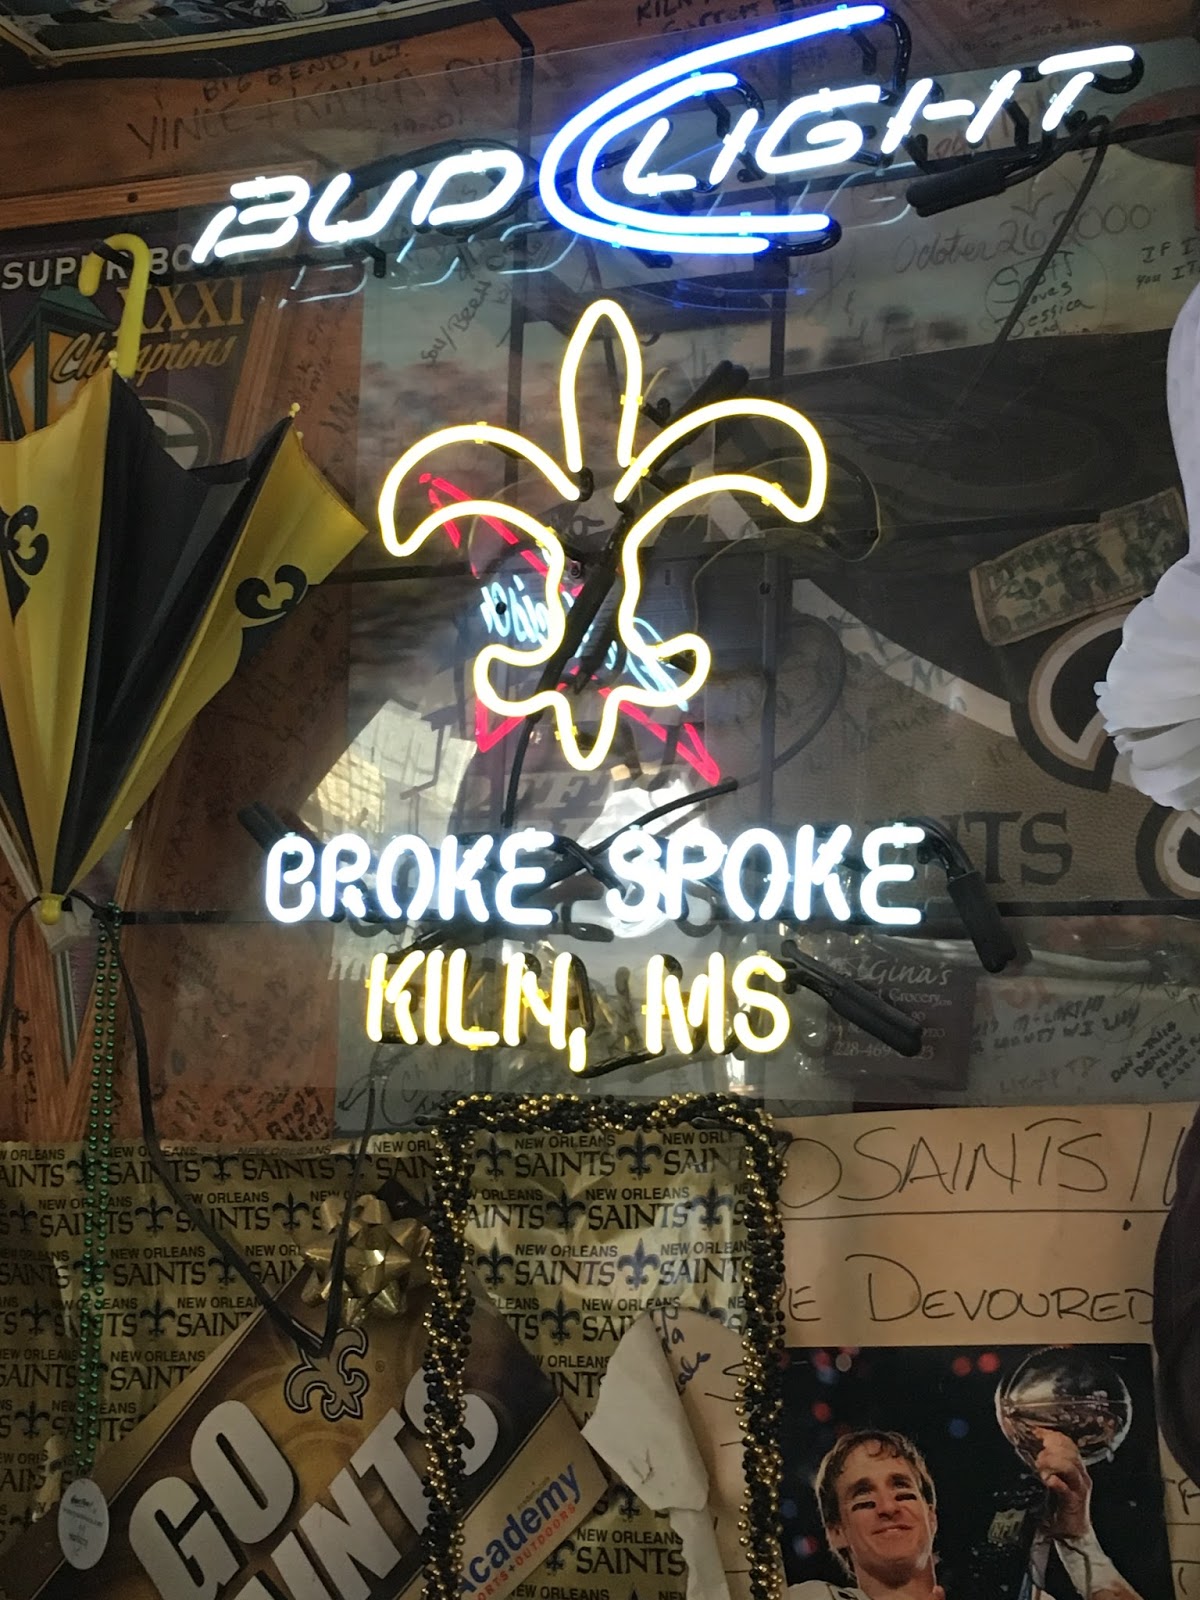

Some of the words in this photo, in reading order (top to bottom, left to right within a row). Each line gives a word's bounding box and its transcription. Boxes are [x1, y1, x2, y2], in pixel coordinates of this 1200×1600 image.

[191, 147, 525, 264] BUD
[622, 44, 1136, 197] LIGHT
[1, 250, 131, 291] SUPR
[51, 332, 239, 388] Chpions
[604, 822, 927, 926] SPOKE
[365, 947, 588, 1073] KILN,
[643, 949, 792, 1055] MS
[374, 1140, 405, 1153] NEW
[514, 1137, 548, 1150] NEW
[550, 1134, 616, 1149] ORLEANS
[662, 1131, 694, 1145] NEW
[10, 1149, 66, 1161] ORLEANS
[514, 1151, 616, 1177] SAINTS
[664, 1148, 748, 1176] SAINT
[0, 1163, 65, 1188] AINTS
[241, 1156, 336, 1181] SAINTS
[376, 1155, 438, 1181] SAIN
[38, 1198, 67, 1211] NEW
[206, 1191, 270, 1204] ORLEANS
[482, 1188, 543, 1201] ORLEANS
[585, 1187, 618, 1201] NEW
[621, 1186, 690, 1200] ORLEANS
[175, 1204, 271, 1233] SINTS
[468, 1203, 545, 1230] AINTS
[588, 1202, 689, 1231] SAINTS
[111, 1248, 140, 1260] NEW
[143, 1245, 206, 1259] ORLEANS
[244, 1244, 277, 1256] NEW
[515, 1243, 548, 1256] NEW
[551, 1243, 618, 1258] ORLEANS
[660, 1242, 691, 1256] NEW
[113, 1261, 207, 1288] SAINTS
[514, 1260, 616, 1287] SAINTS
[176, 1296, 207, 1309] NEW
[210, 1296, 262, 1309] ORLEAN
[496, 1297, 540, 1310] LEANS
[581, 1298, 614, 1312] NEW
[176, 1312, 252, 1338] SAIN
[23, 1348, 78, 1361] ORLEANS
[111, 1350, 143, 1362] NEW
[145, 1350, 206, 1362] ORLEANS
[110, 1365, 195, 1391] SAINT
[228, 1368, 500, 1600] INTS
[128, 1399, 296, 1600] GO
[576, 1528, 609, 1543] NEW
[575, 1546, 688, 1575] SAINTS
[539, 1585, 611, 1600] ORLEANS
